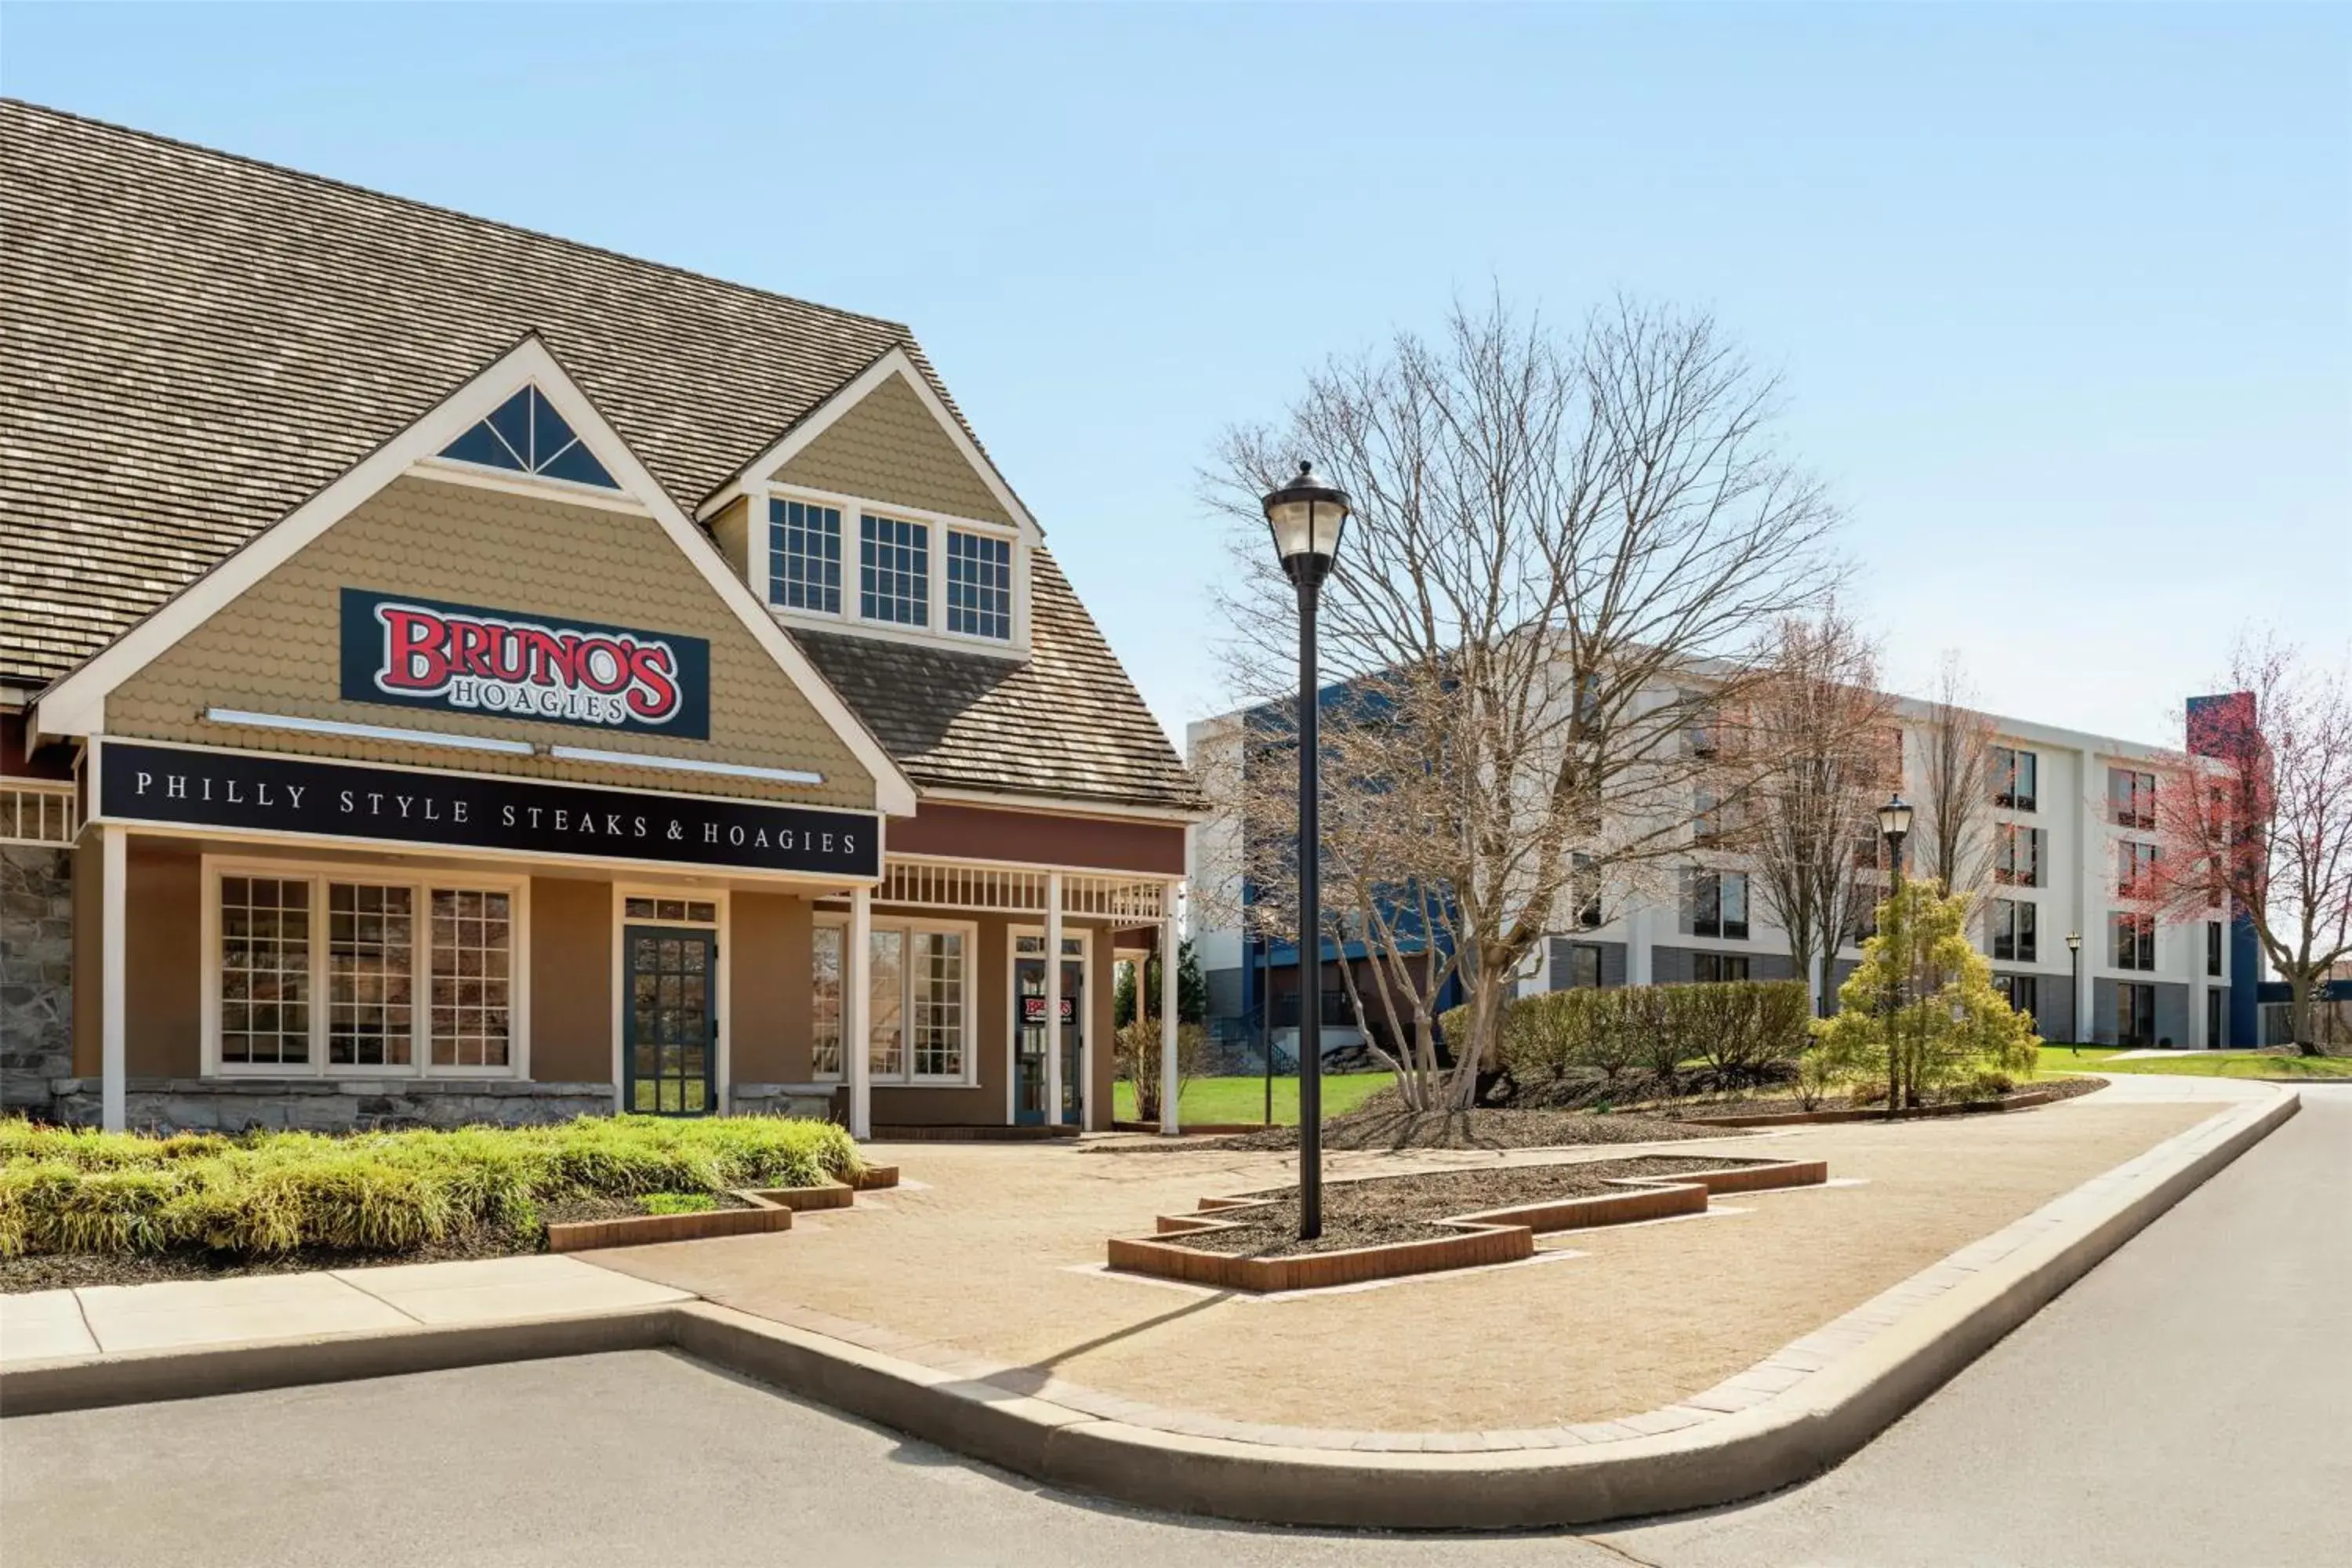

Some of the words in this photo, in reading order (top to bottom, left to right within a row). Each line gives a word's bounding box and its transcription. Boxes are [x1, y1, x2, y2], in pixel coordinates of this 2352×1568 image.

[380, 608, 676, 718] BRUNO'S
[454, 680, 622, 719] HOAGIES
[136, 772, 304, 808] PHILLY
[341, 791, 467, 822] STYLE
[503, 806, 645, 836] STEAKS
[668, 820, 682, 839] &
[705, 823, 853, 853] HOAGIES
